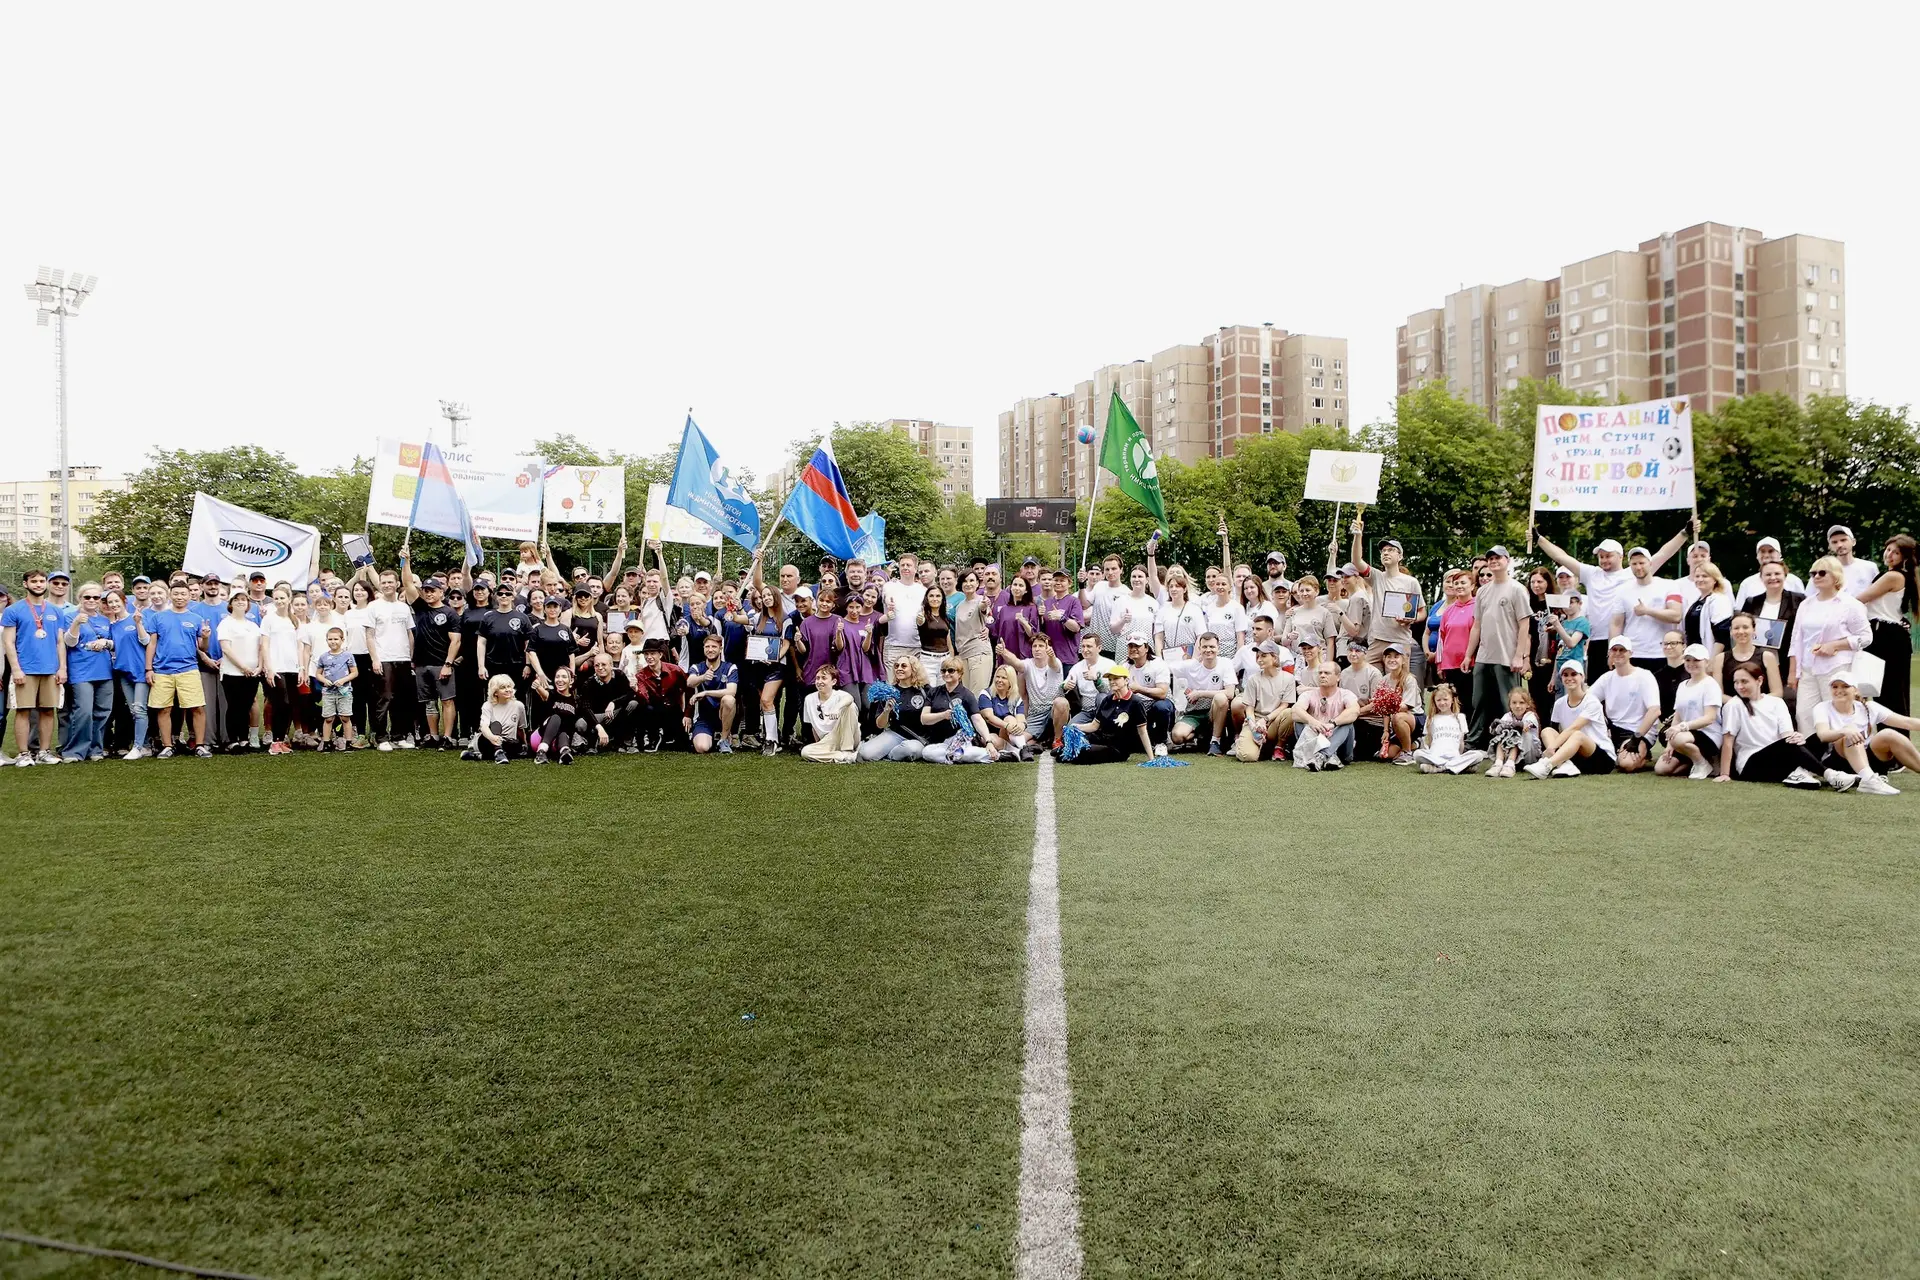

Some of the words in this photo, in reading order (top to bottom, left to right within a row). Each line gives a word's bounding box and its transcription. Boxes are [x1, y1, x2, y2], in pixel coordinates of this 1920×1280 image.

[1554, 434, 1590, 445] РИТМ
[1602, 431, 1655, 443] СТУЧИТ
[219, 537, 277, 557] ВНИИИМТ
